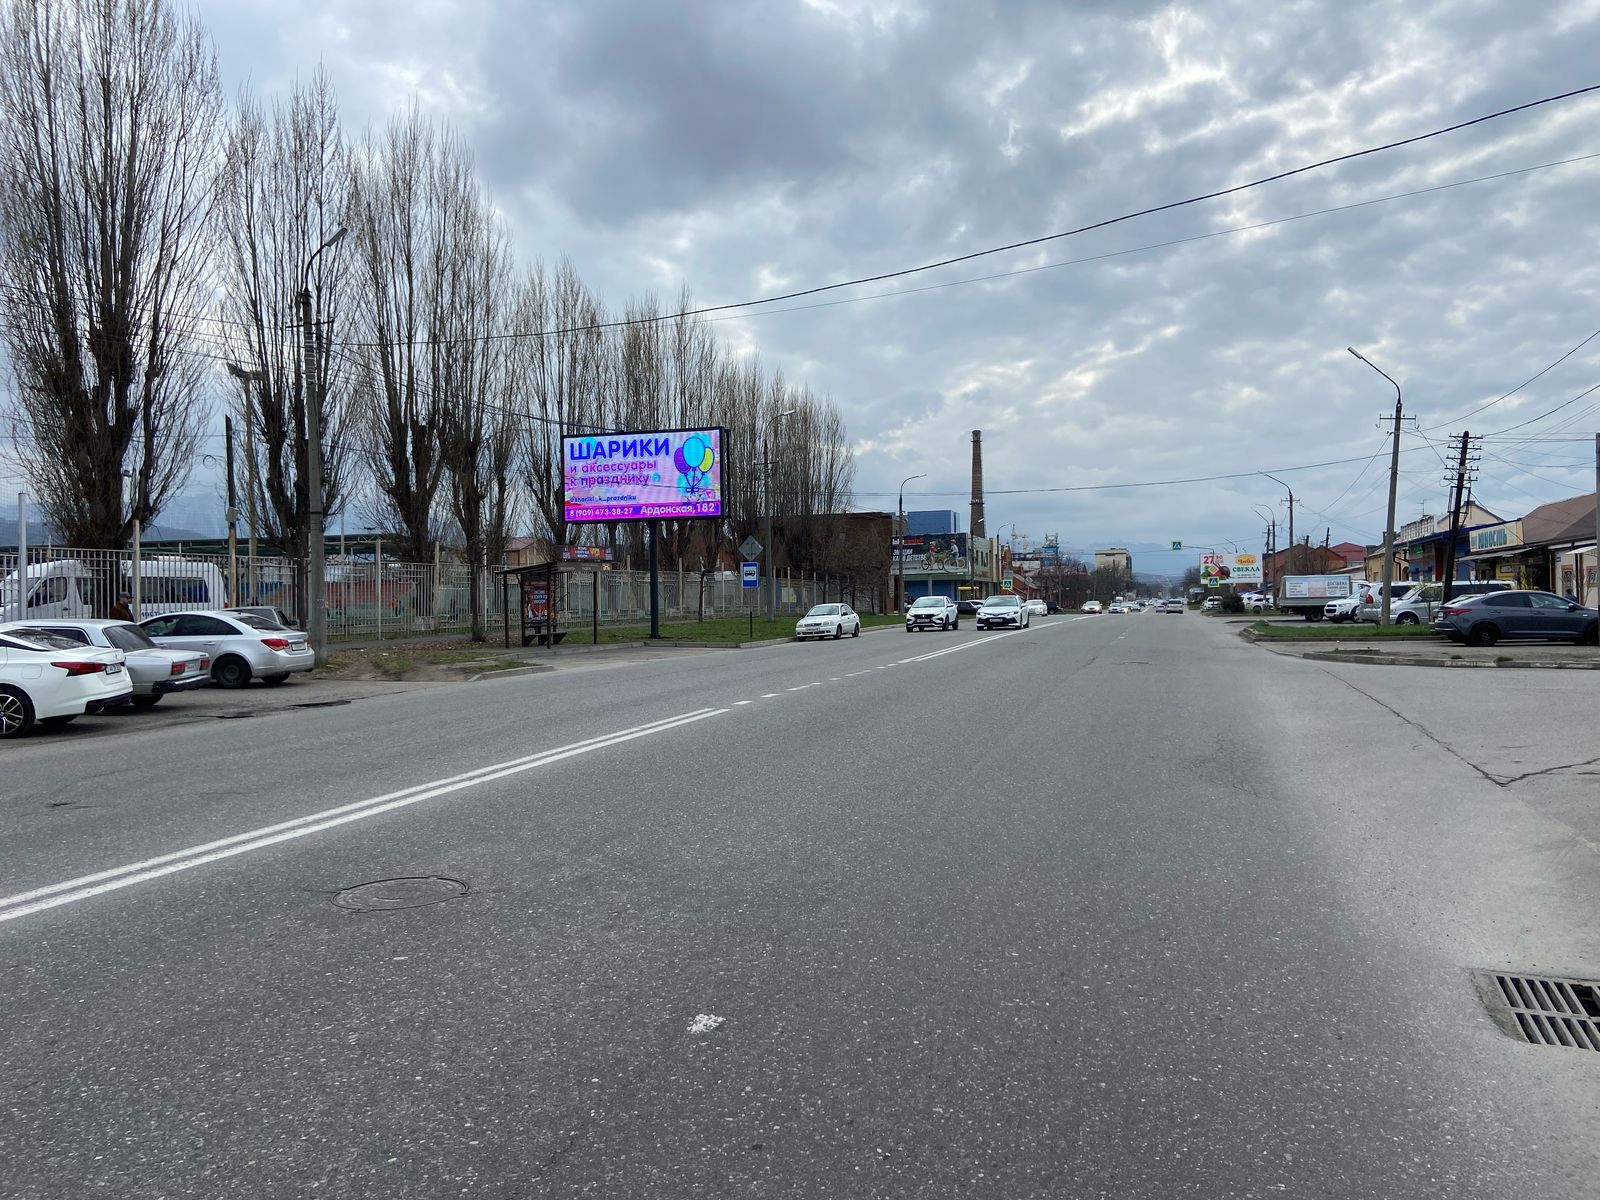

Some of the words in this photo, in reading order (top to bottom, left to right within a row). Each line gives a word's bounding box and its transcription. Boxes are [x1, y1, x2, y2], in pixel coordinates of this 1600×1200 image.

[570, 437, 669, 460] ШАРИКИ
[570, 466, 577, 474] и
[582, 459, 657, 475] аксессуары
[570, 478, 577, 487] к
[581, 474, 650, 488] празднику
[575, 509, 594, 518] (909)
[595, 507, 633, 515] 473-38-27
